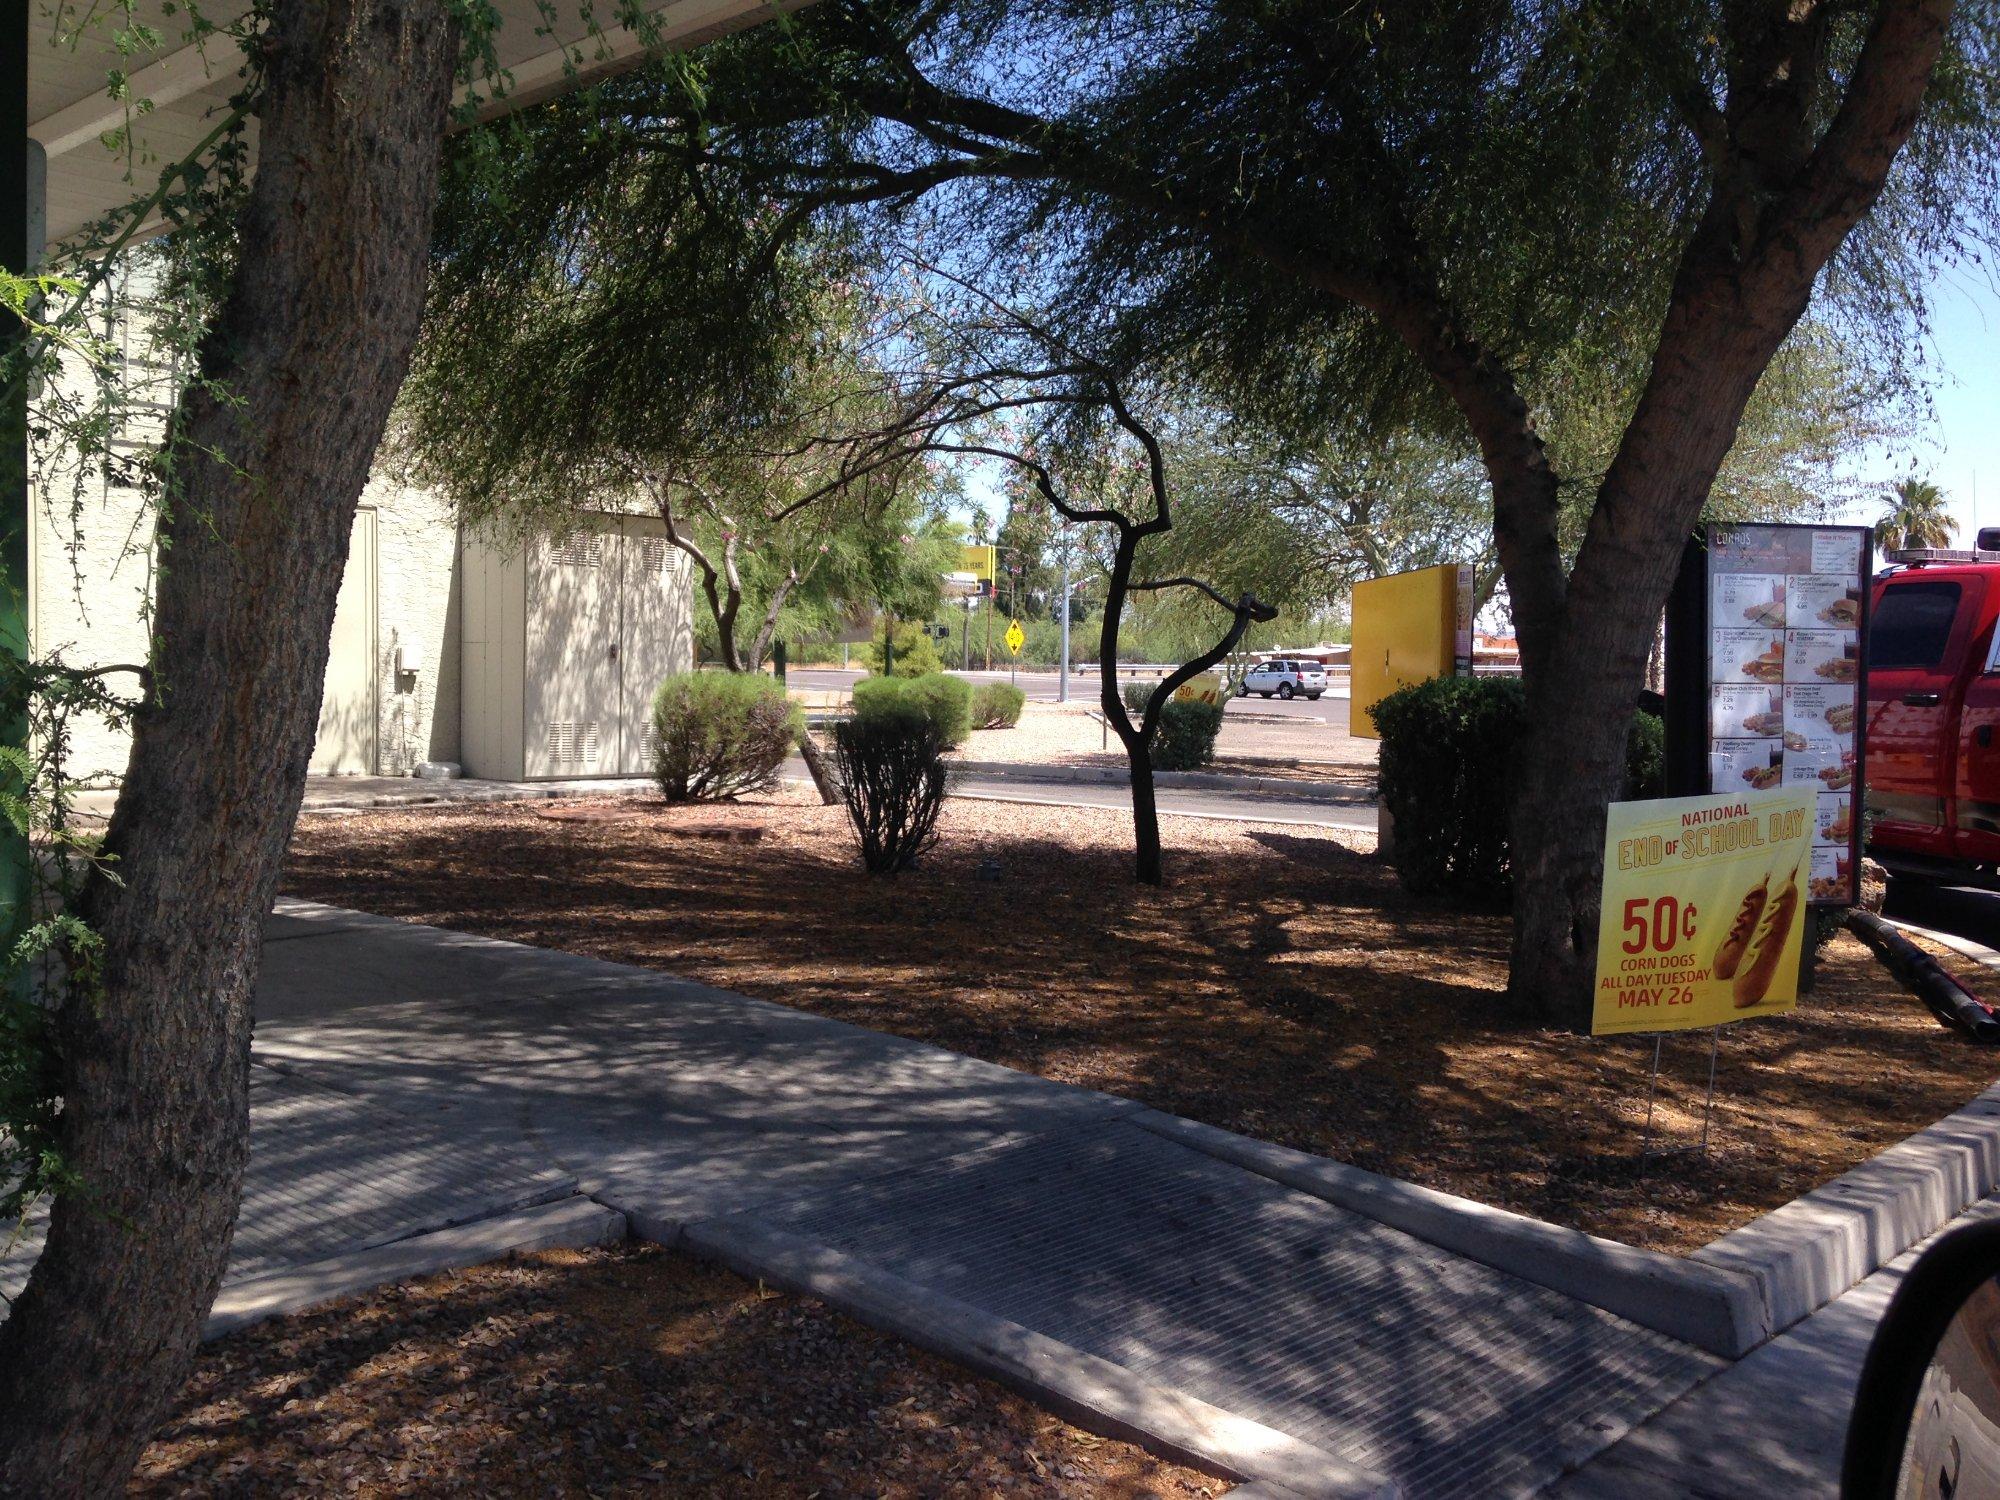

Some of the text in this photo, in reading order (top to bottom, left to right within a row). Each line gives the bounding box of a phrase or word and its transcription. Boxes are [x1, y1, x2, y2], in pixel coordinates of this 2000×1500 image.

[1788, 632, 1794, 643] 4
[1714, 686, 1720, 697] 5
[1786, 687, 1791, 698] 6
[1682, 802, 1749, 826] NATIONAL
[1618, 808, 1806, 870] END OF SCHOOL DAY
[1622, 896, 1697, 955] 50¢
[1620, 953, 1695, 972] CORN DOGS
[1601, 968, 1712, 990] ALL DAY TUESDAY
[1618, 986, 1694, 1009] MAY 26
